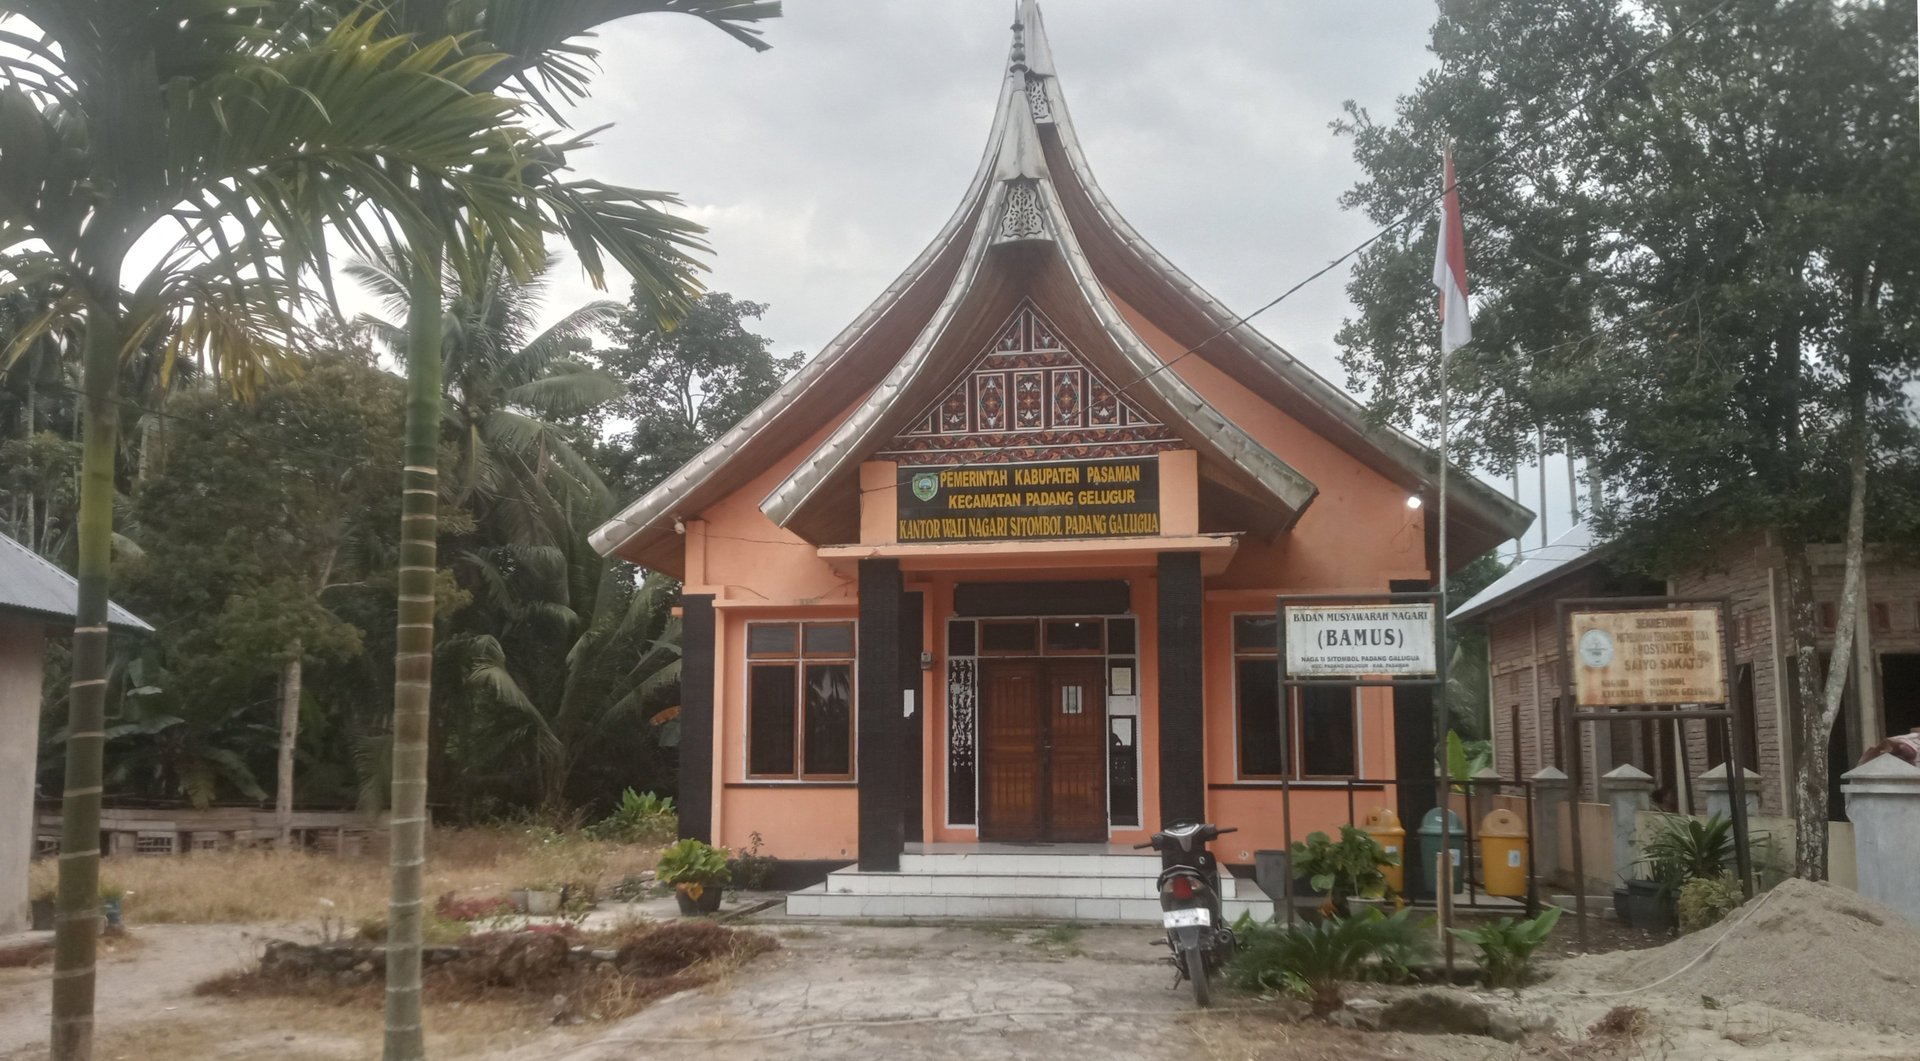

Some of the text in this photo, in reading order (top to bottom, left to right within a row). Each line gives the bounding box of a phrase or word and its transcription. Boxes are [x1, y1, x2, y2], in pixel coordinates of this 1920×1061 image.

[940, 465, 1140, 488] PEMERINTAH KABUPATEN PASAMAN
[948, 489, 1135, 509] KECAMATAN PADANG GELUGUR
[899, 512, 1159, 540] KANTOR WALI NAGARI SITOMBOL PADANG GALUGUA
[1293, 611, 1428, 622] BADAN MUSYAWARAH NAGARI
[1317, 628, 1404, 650] (BAMUS)
[1624, 659, 1657, 671] SAIYO
